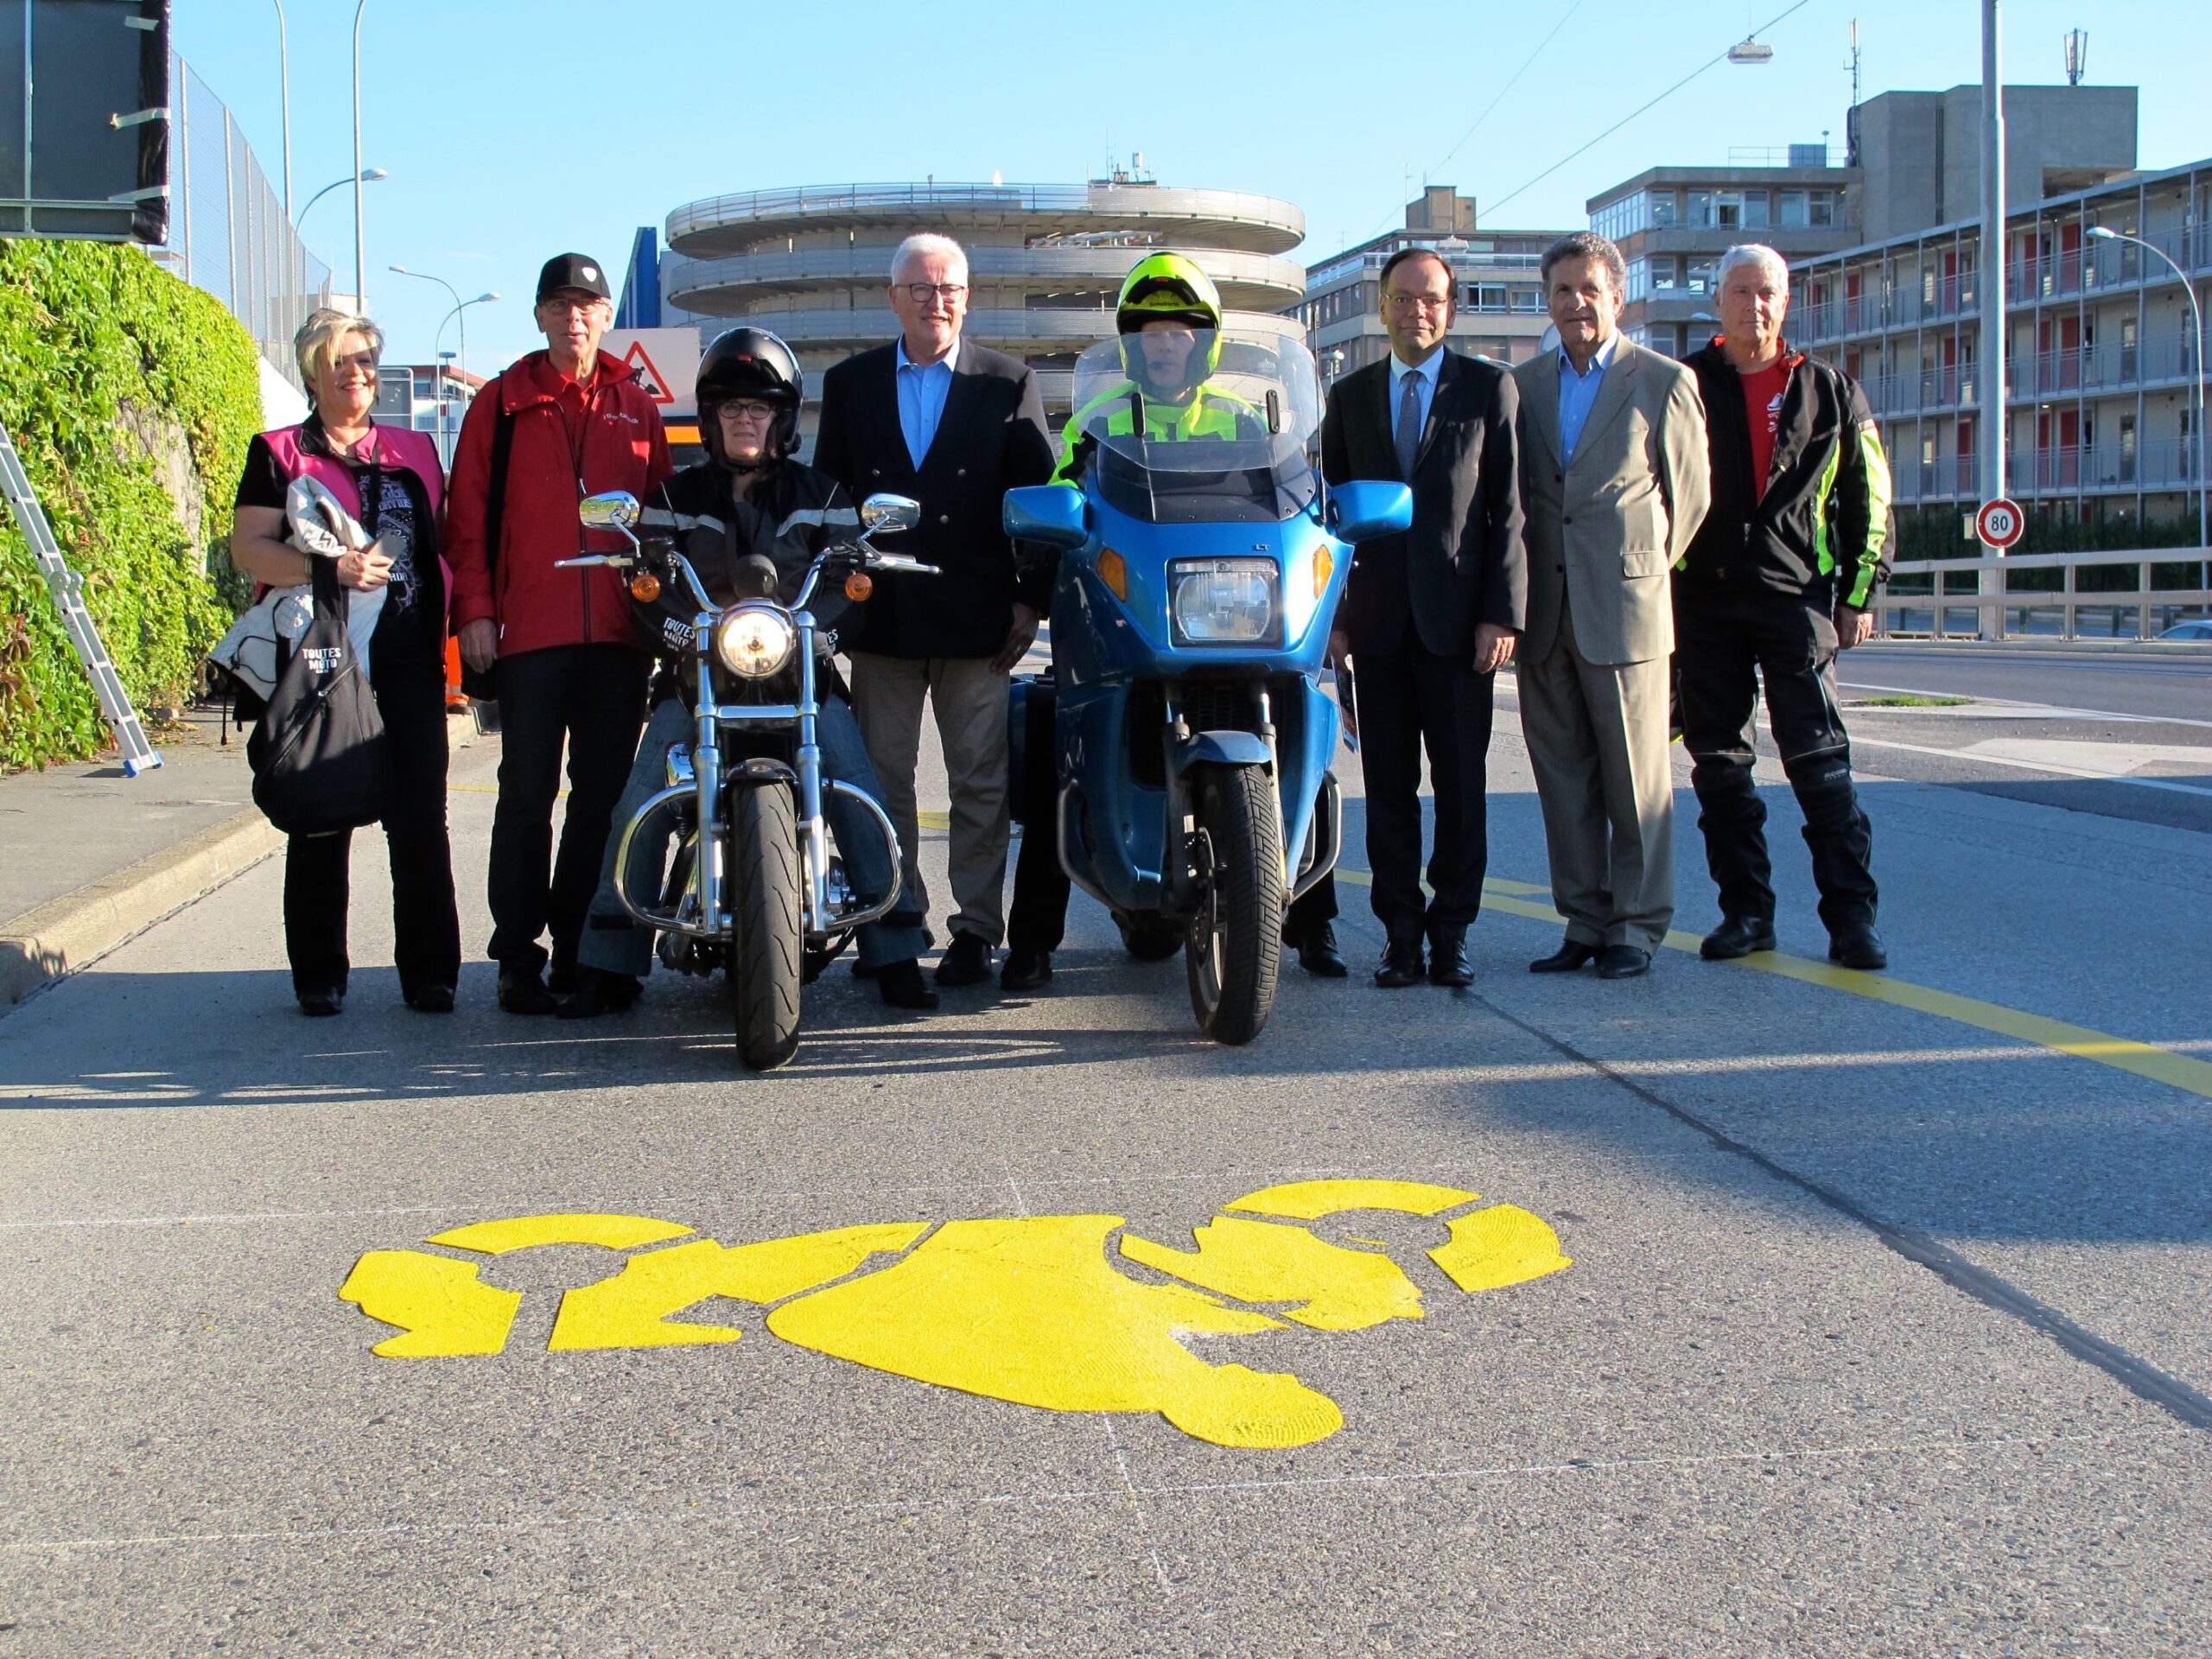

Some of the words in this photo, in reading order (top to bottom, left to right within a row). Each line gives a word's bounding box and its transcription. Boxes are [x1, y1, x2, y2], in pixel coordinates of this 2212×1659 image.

[1991, 516, 2008, 531] 80
[664, 617, 696, 639] TOUTES
[302, 647, 342, 659] TOUTES
[308, 658, 338, 671] MOTO
